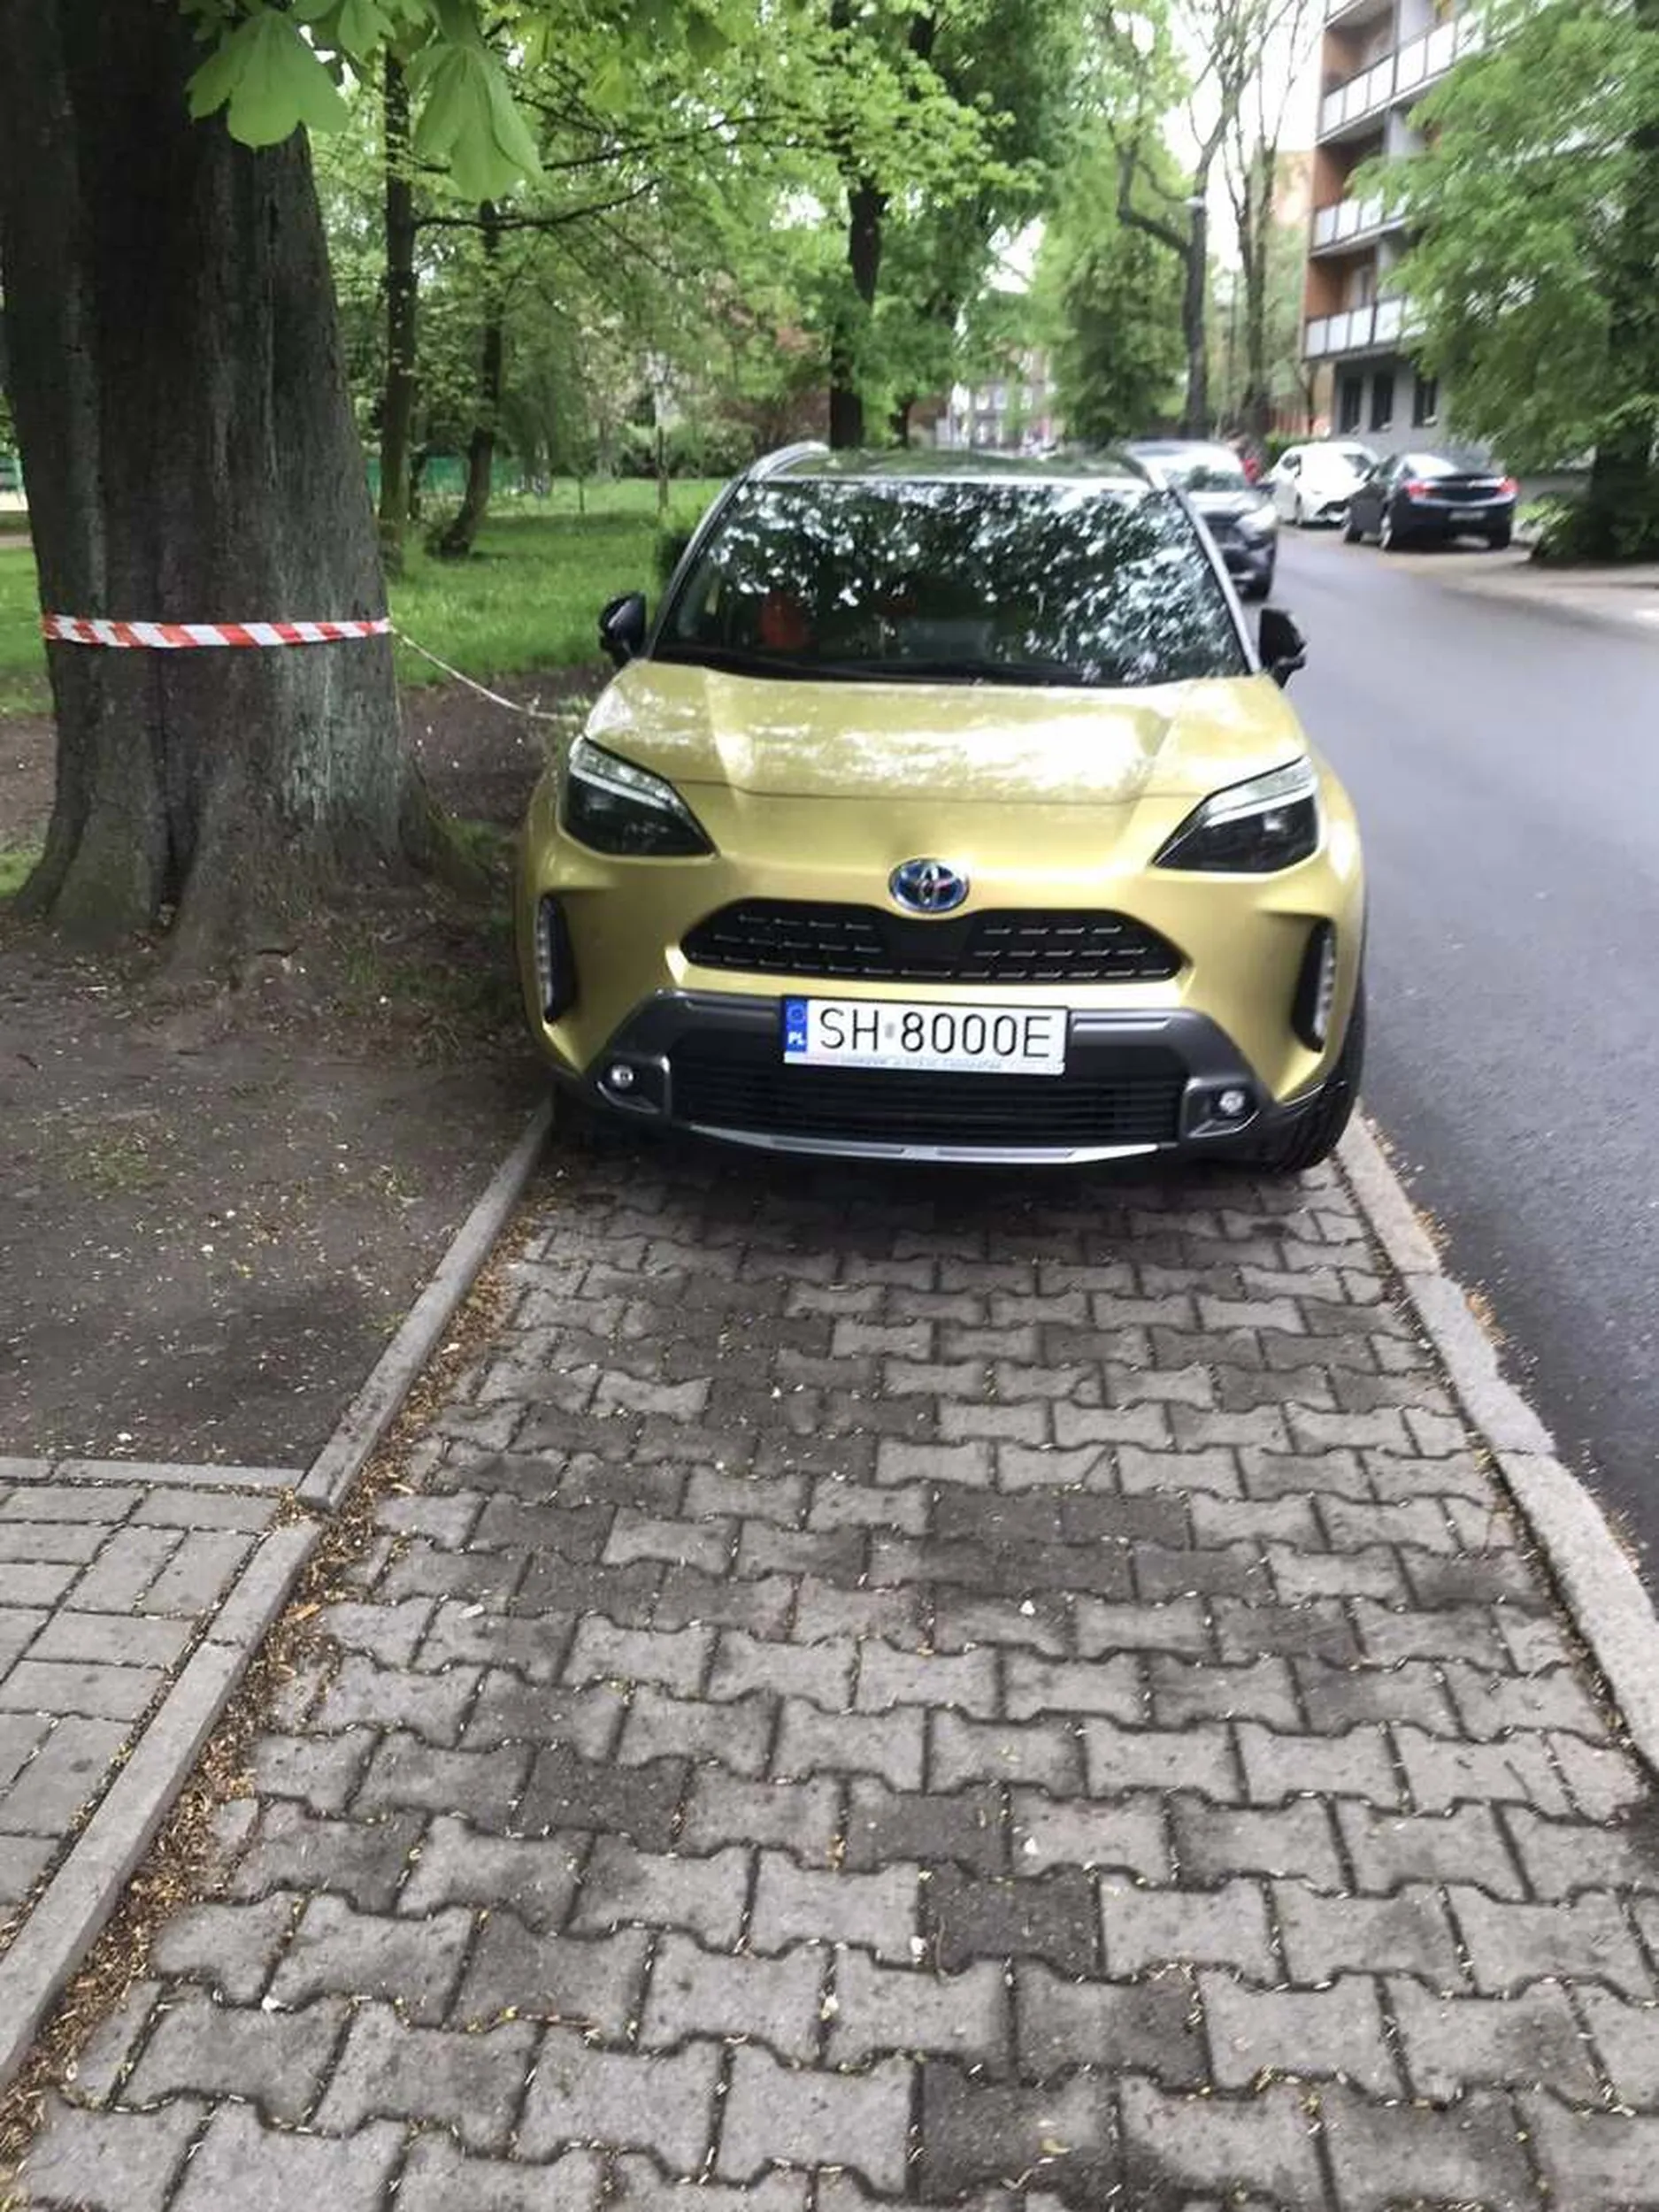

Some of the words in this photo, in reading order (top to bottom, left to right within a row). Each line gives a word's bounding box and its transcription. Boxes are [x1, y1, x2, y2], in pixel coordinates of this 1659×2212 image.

[787, 1031, 806, 1045] PL
[819, 1008, 879, 1051] SH
[901, 1011, 1053, 1057] 8000E
